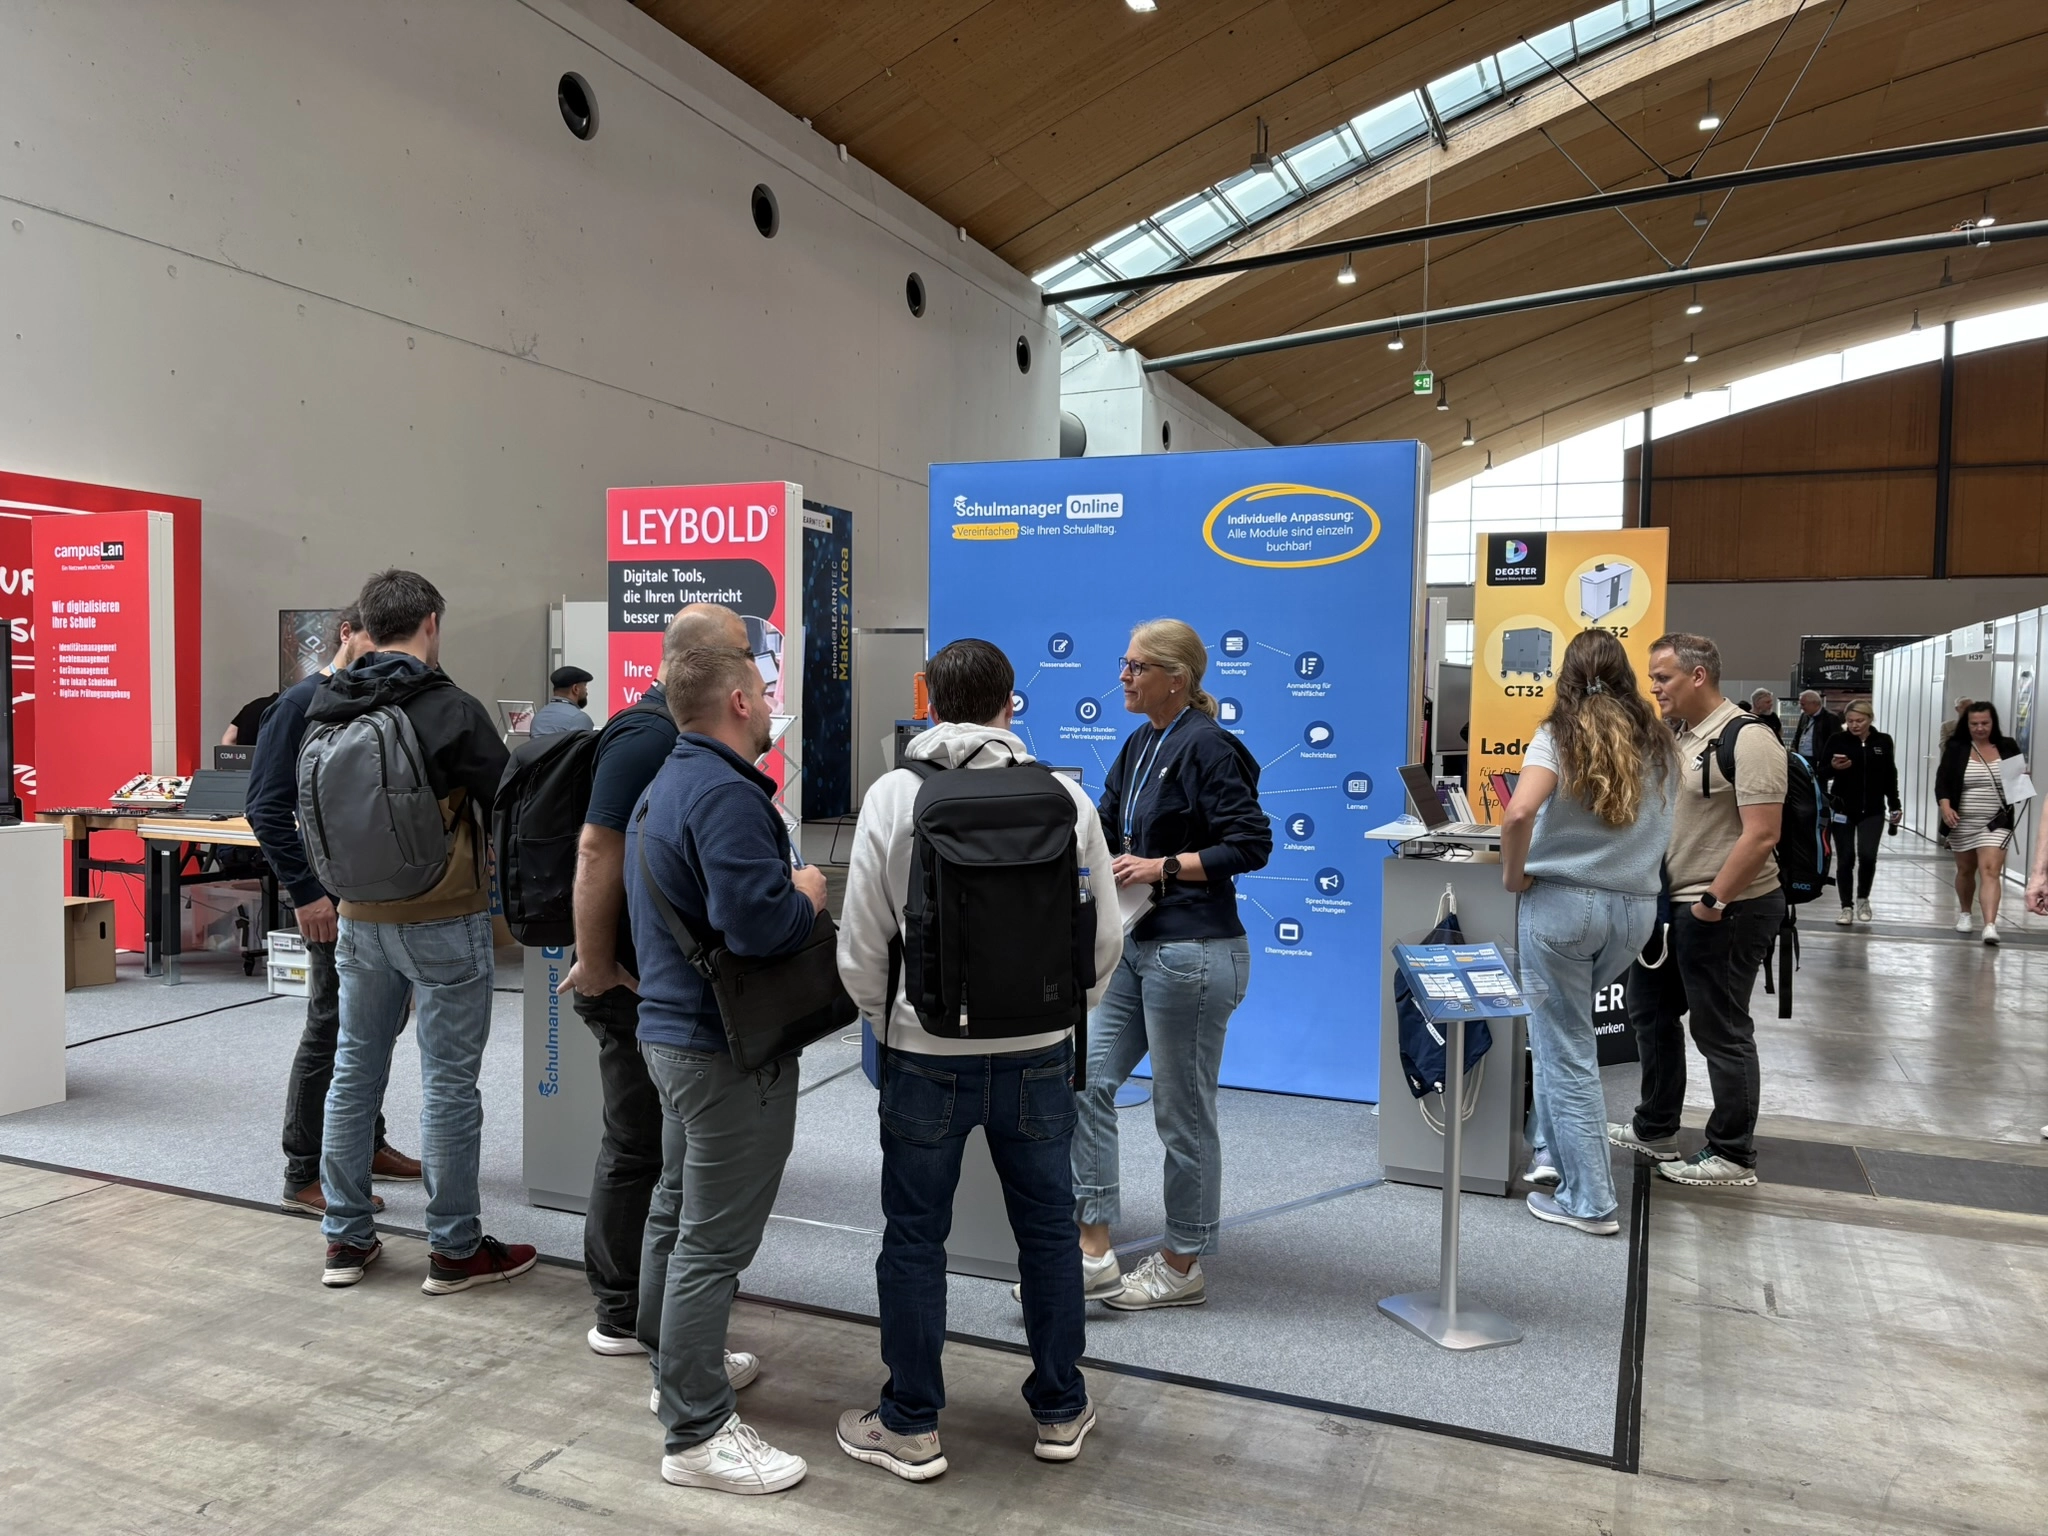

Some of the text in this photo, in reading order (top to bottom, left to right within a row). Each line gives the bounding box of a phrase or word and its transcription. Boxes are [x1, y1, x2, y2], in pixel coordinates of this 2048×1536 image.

[956, 499, 1119, 518] Schulmanager Online
[803, 516, 824, 528] EARNTEC
[1228, 511, 1354, 525] Individuelle Anpassung:
[957, 523, 1117, 537] Vereinfachen Sie Ihren Schulalltag.
[1227, 525, 1353, 539] Alle Module sind einzeln
[54, 541, 123, 561] campusLan
[1266, 541, 1312, 552] buchbar!
[623, 568, 706, 586] Digitale Tools,
[1495, 568, 1537, 576] DEQSTER
[623, 589, 742, 603] die Ihren Unterricht
[52, 599, 120, 614] Wir digitalisieren
[623, 610, 660, 624] besser
[839, 547, 849, 680] Makers Area
[52, 616, 97, 628] Ihre Schule
[1825, 650, 1857, 658] MENU
[624, 660, 653, 678] Ihre
[1221, 668, 1247, 676] buchung
[1286, 682, 1321, 690] Anmeldung
[1504, 685, 1544, 698] CT32
[1284, 843, 1315, 851] Zahlungen
[1305, 898, 1352, 906] Sprechstunden-
[1312, 906, 1346, 914] buchungen
[1265, 946, 1312, 956] Elterngespräche
[545, 964, 559, 1094] Schulmanager
